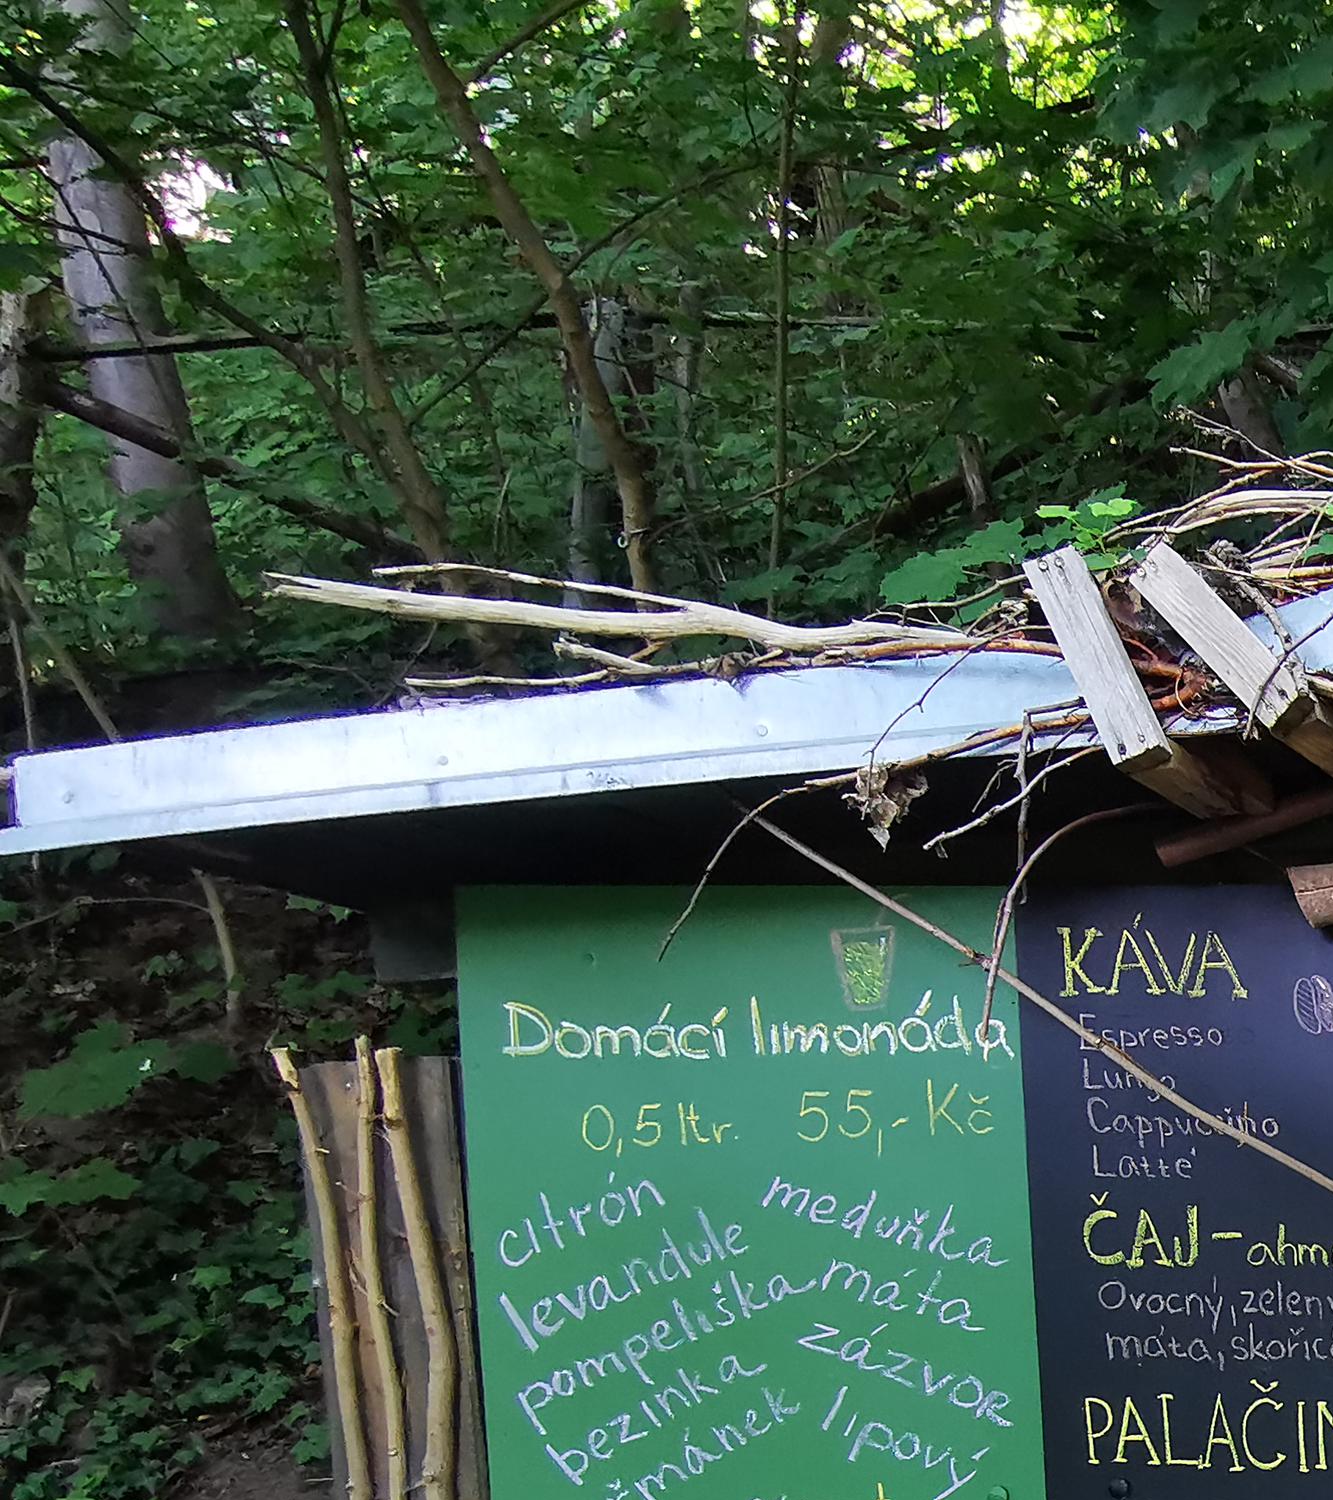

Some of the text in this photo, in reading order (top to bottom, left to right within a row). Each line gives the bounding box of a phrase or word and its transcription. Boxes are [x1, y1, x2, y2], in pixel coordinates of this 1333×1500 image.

[1057, 911, 1248, 1000] KÁVA
[502, 990, 1015, 1061] Domácí limonáda
[1079, 1013, 1222, 1049] Espresso
[926, 1079, 994, 1136] Kč
[762, 1175, 1009, 1268] meduňka
[1083, 1191, 1199, 1269] ČAJ
[499, 1206, 749, 1354] levandule
[818, 1258, 984, 1333] máta
[545, 1353, 767, 1487] bezinka
